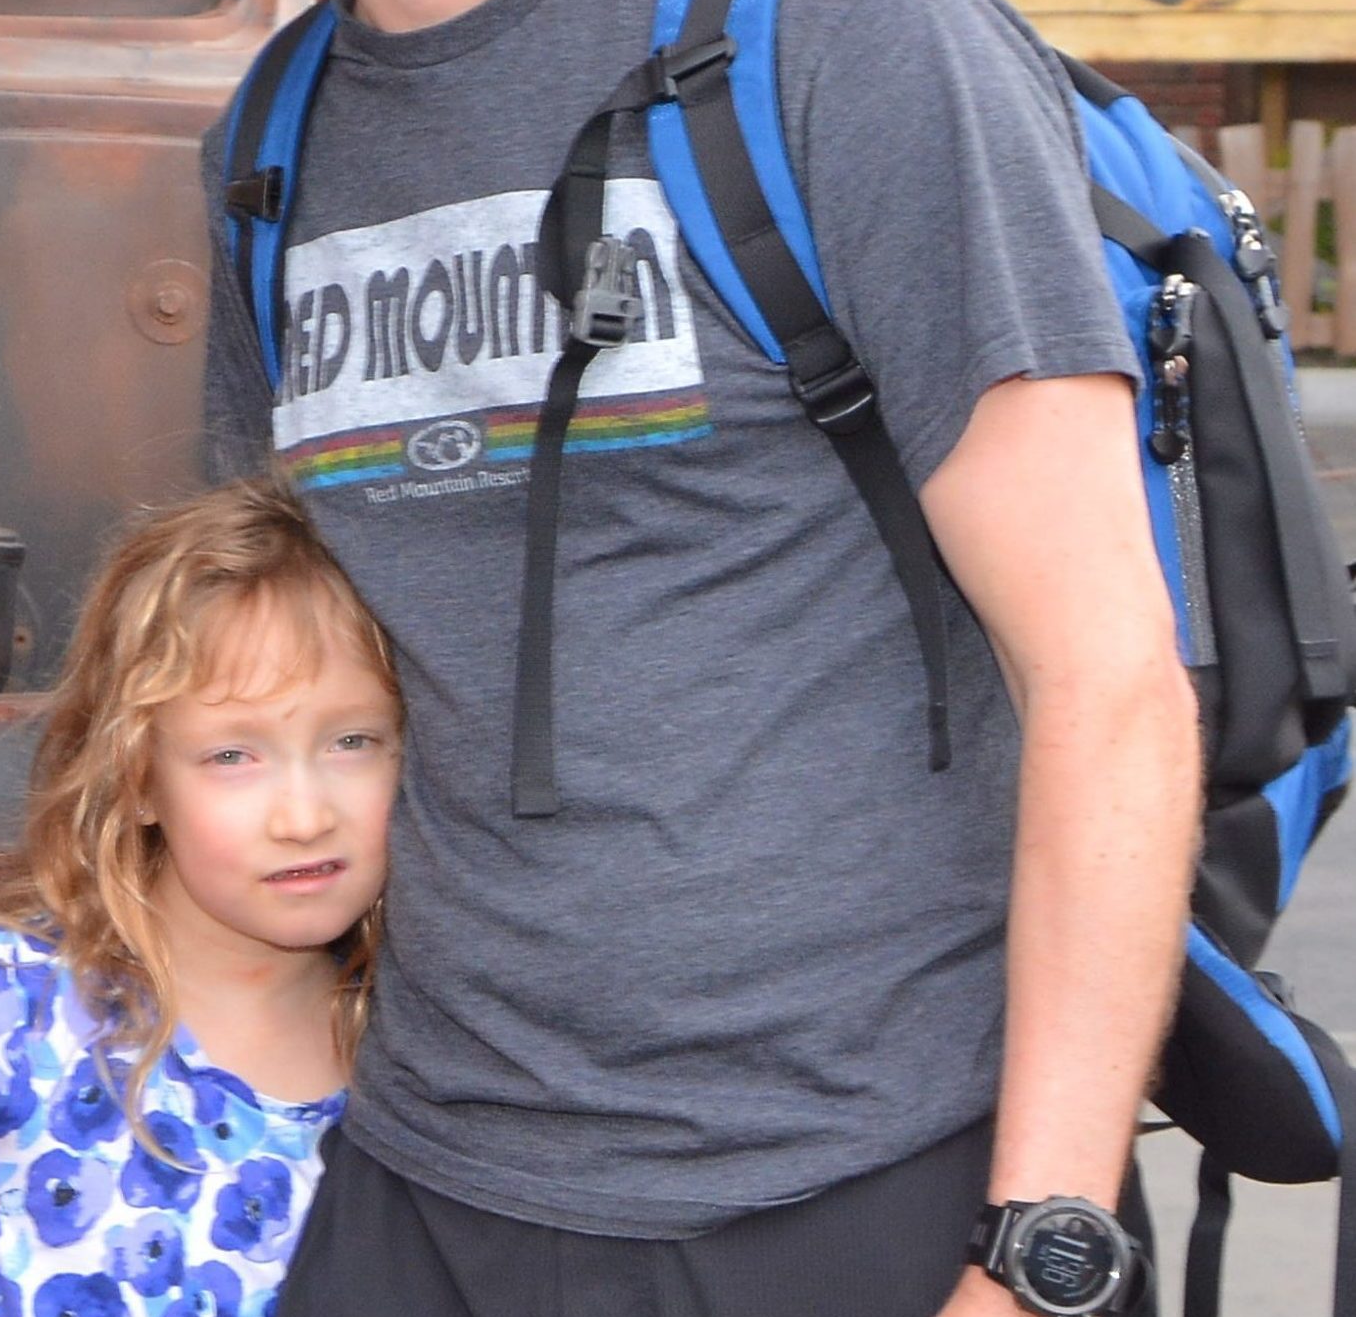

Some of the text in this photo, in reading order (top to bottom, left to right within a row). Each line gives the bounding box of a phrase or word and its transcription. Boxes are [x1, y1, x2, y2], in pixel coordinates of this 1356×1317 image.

[278, 282, 352, 404] ED
[365, 483, 398, 505] Red
[400, 471, 475, 500] Mountain
